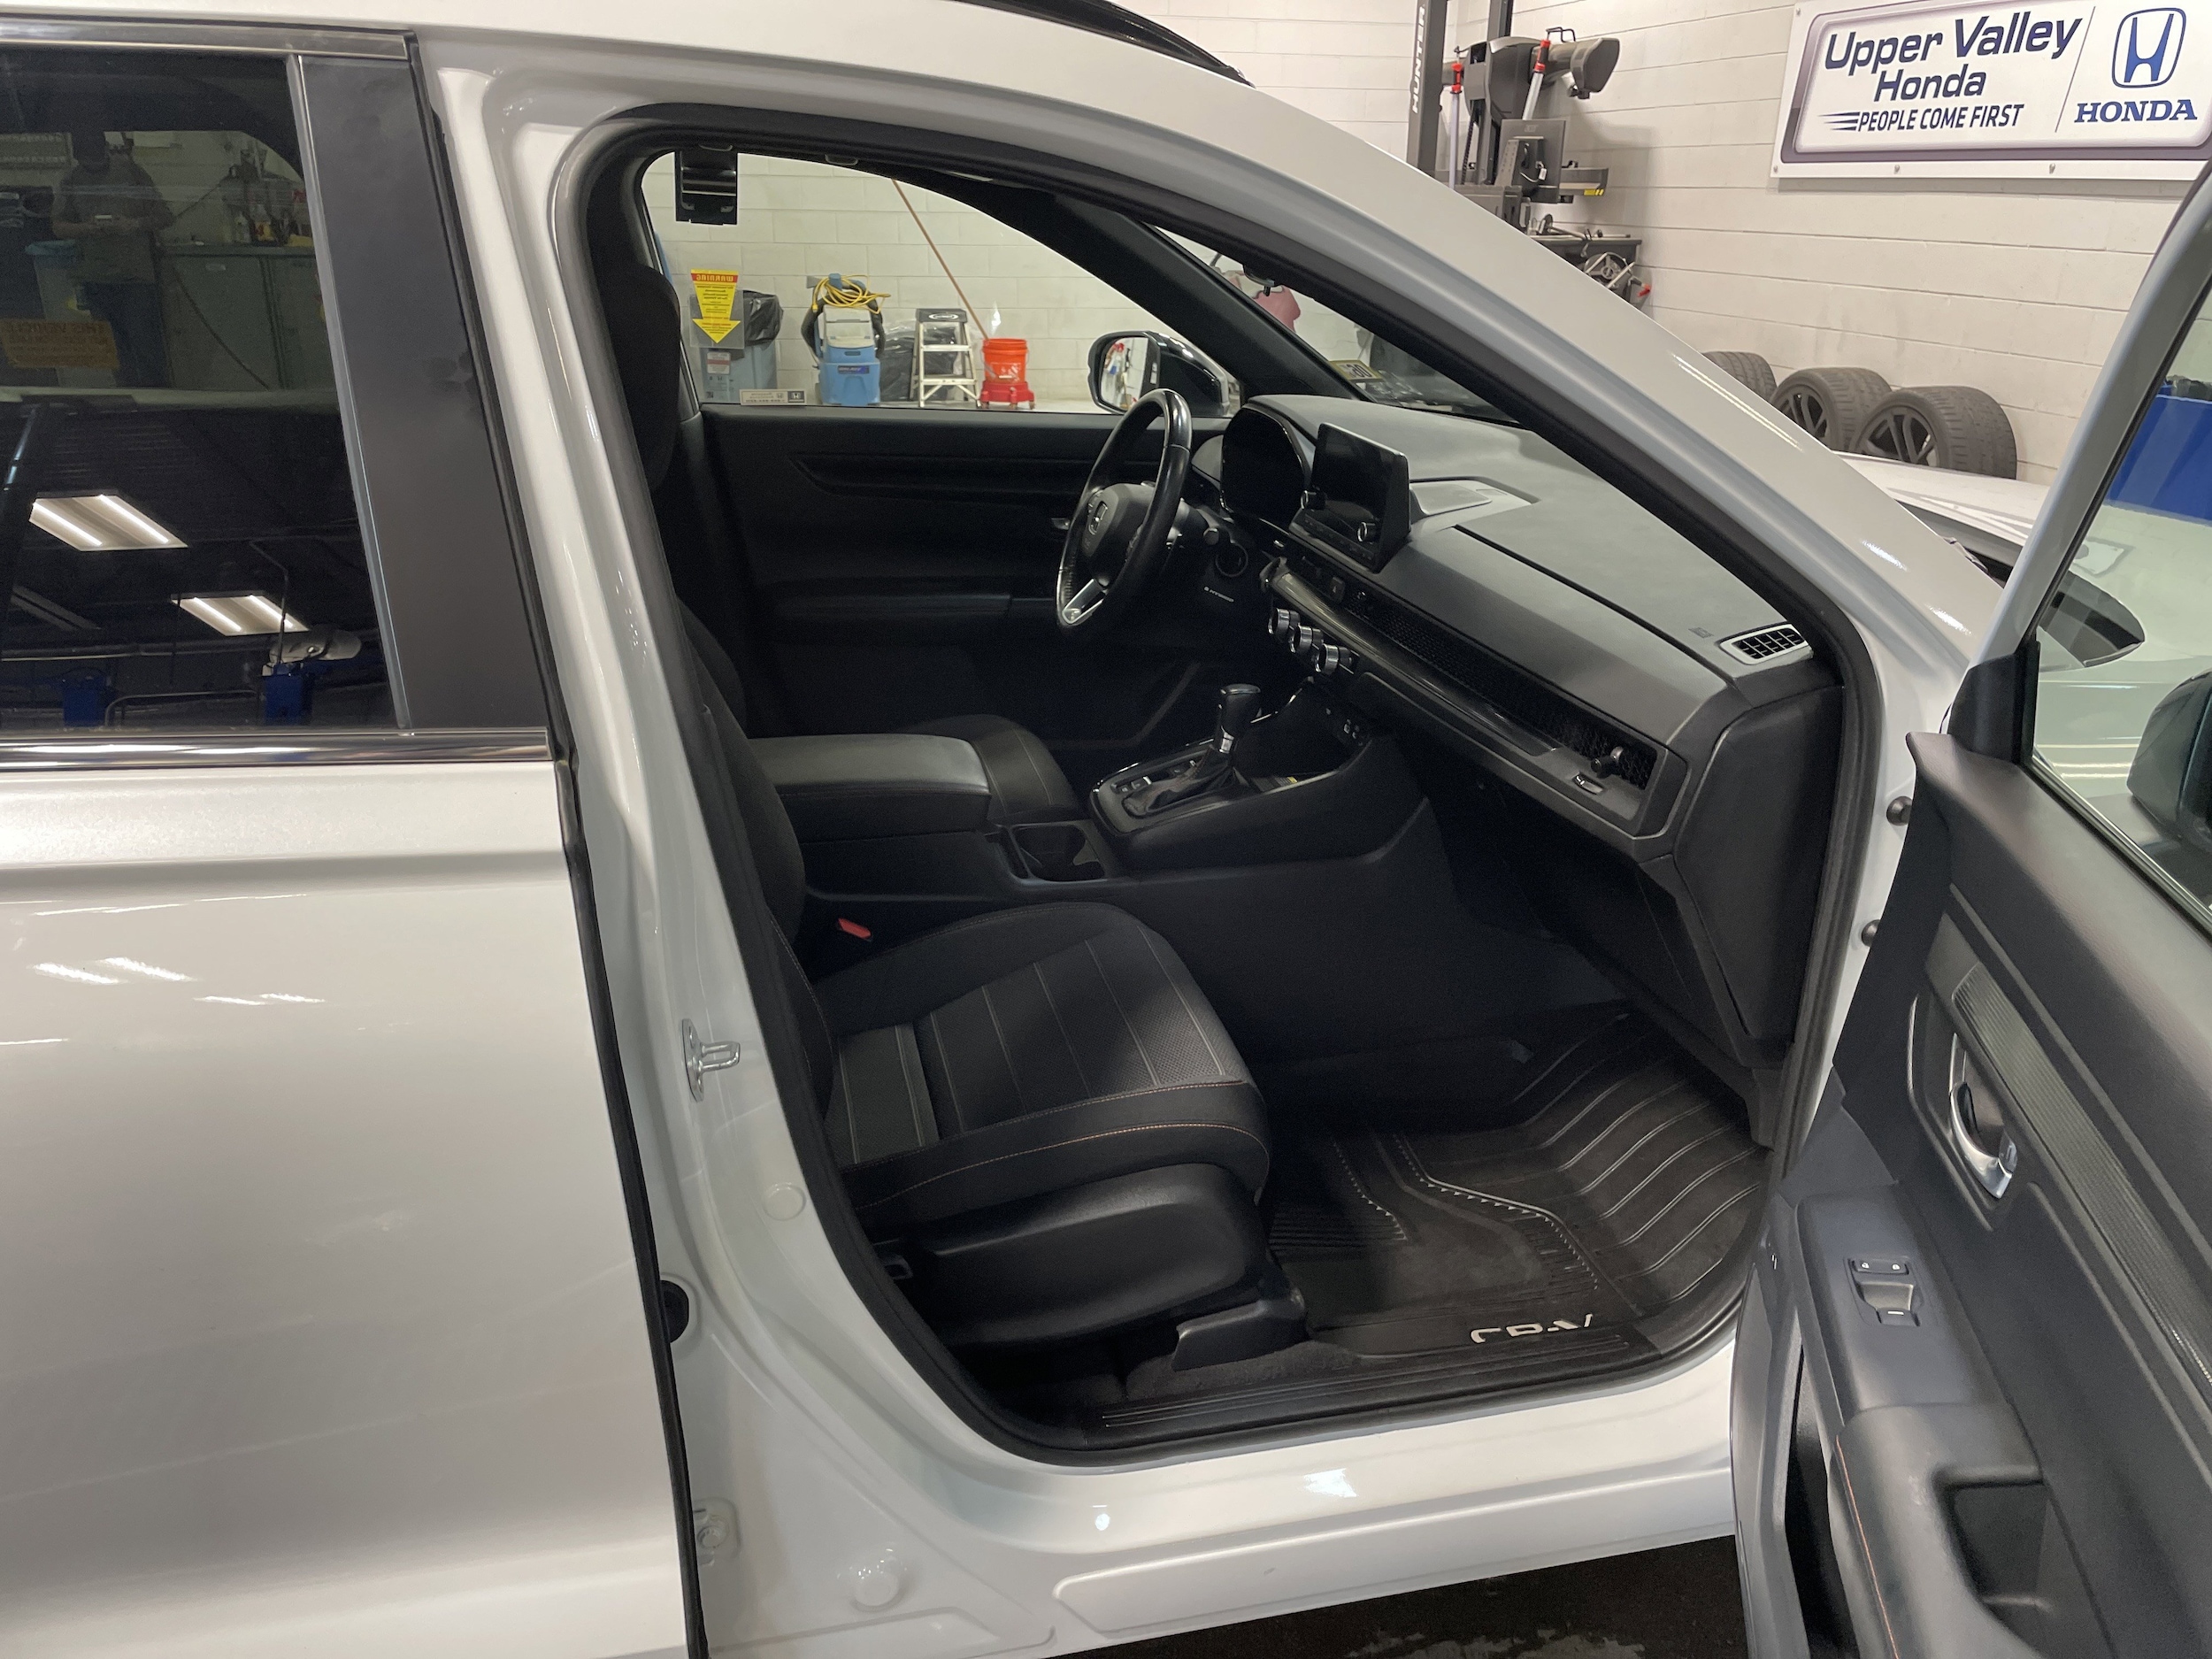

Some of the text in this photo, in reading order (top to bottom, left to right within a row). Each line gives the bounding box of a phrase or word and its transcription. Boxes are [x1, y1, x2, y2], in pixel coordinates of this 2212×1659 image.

[1412, 6, 1425, 113] HUNTER
[1824, 12, 2083, 76] Upper Valley
[1874, 64, 1987, 103] Honda
[1858, 104, 2024, 133] PEOPLE COME FIRST
[2074, 99, 2198, 123] HONDA
